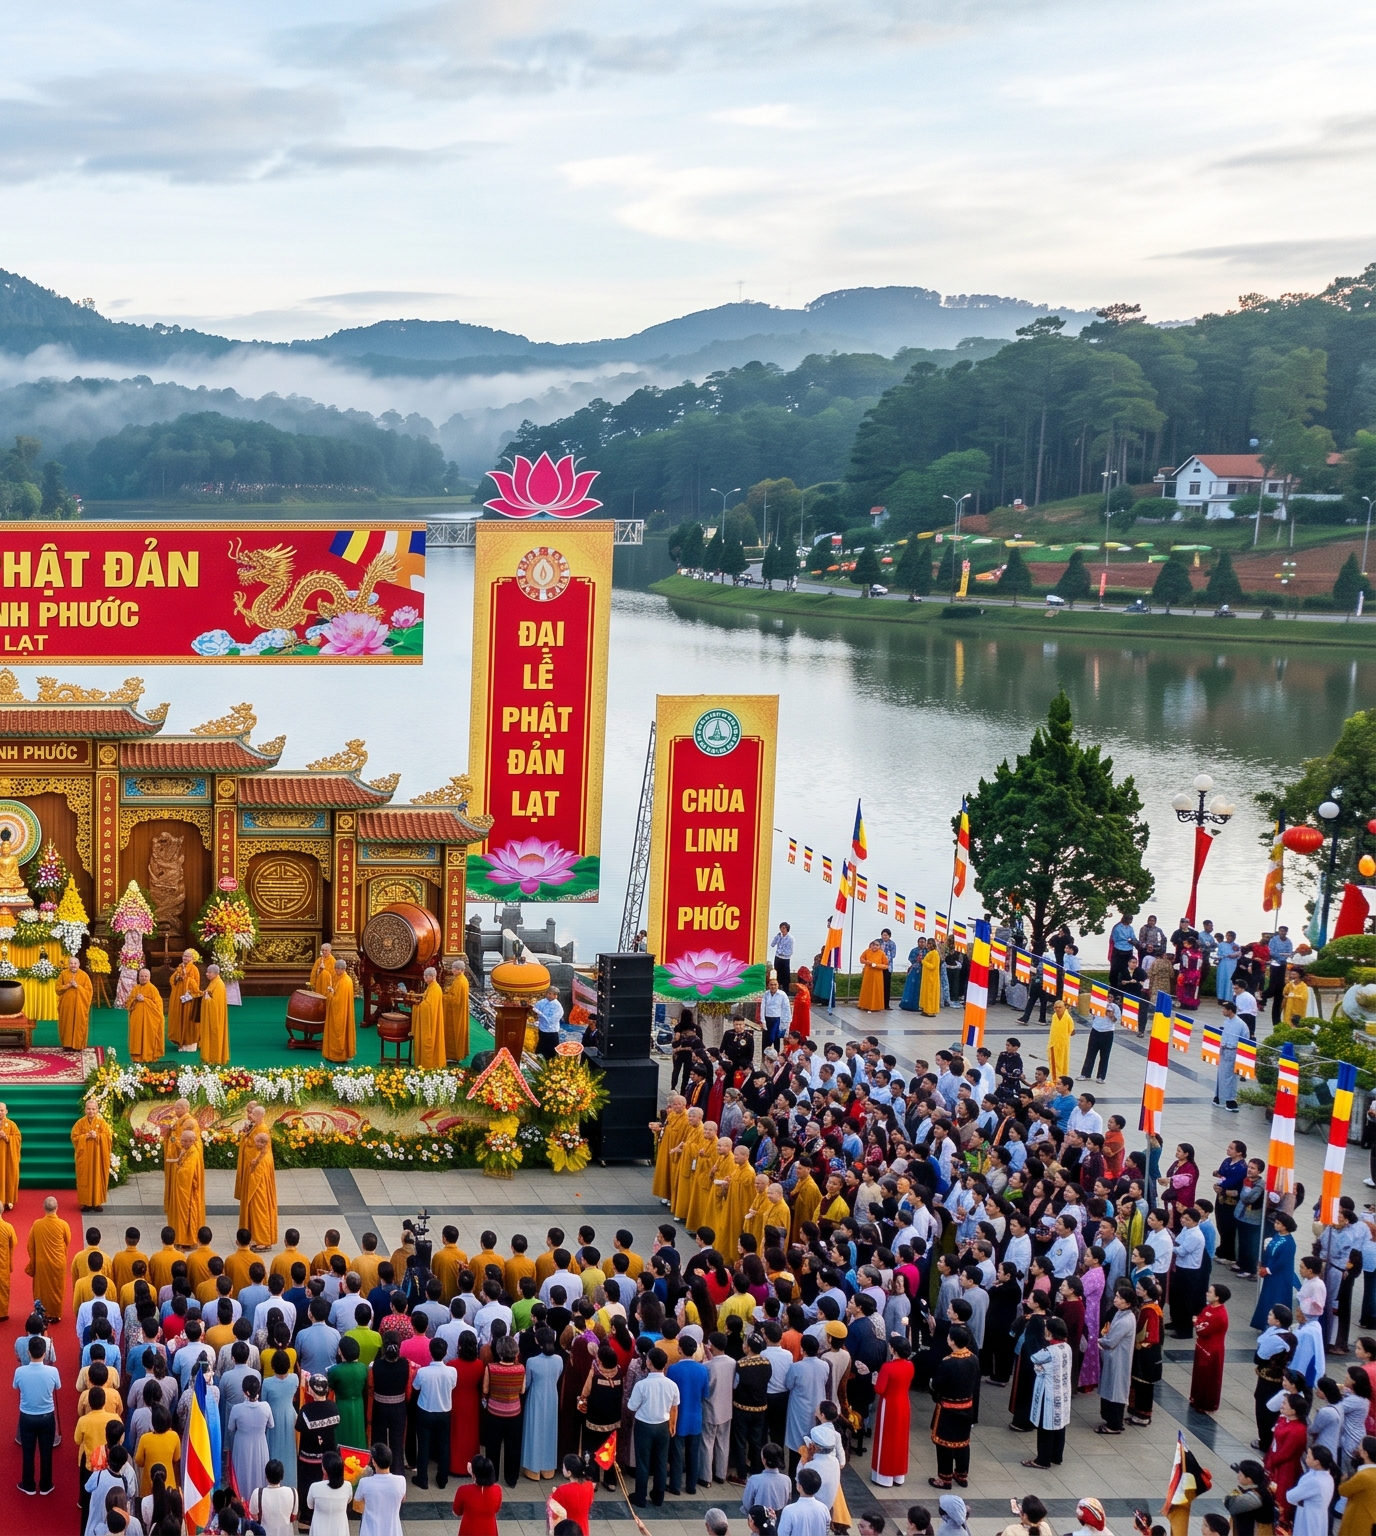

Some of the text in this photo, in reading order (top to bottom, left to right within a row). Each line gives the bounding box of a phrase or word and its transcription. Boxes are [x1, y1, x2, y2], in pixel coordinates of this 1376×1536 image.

[102, 537, 199, 588] ĐẢN
[39, 596, 139, 628] PHƯỚC
[4, 634, 49, 656] LẠT
[517, 621, 565, 653] ĐẠI
[523, 652, 554, 690] LỄ
[502, 701, 573, 739] PHẬT
[507, 740, 565, 775] ĐẢN
[511, 790, 560, 823] LẠT
[681, 783, 745, 813] CHÙA
[685, 828, 739, 852] LINH
[695, 862, 726, 892] VÀ
[677, 901, 741, 931] PHỚC
